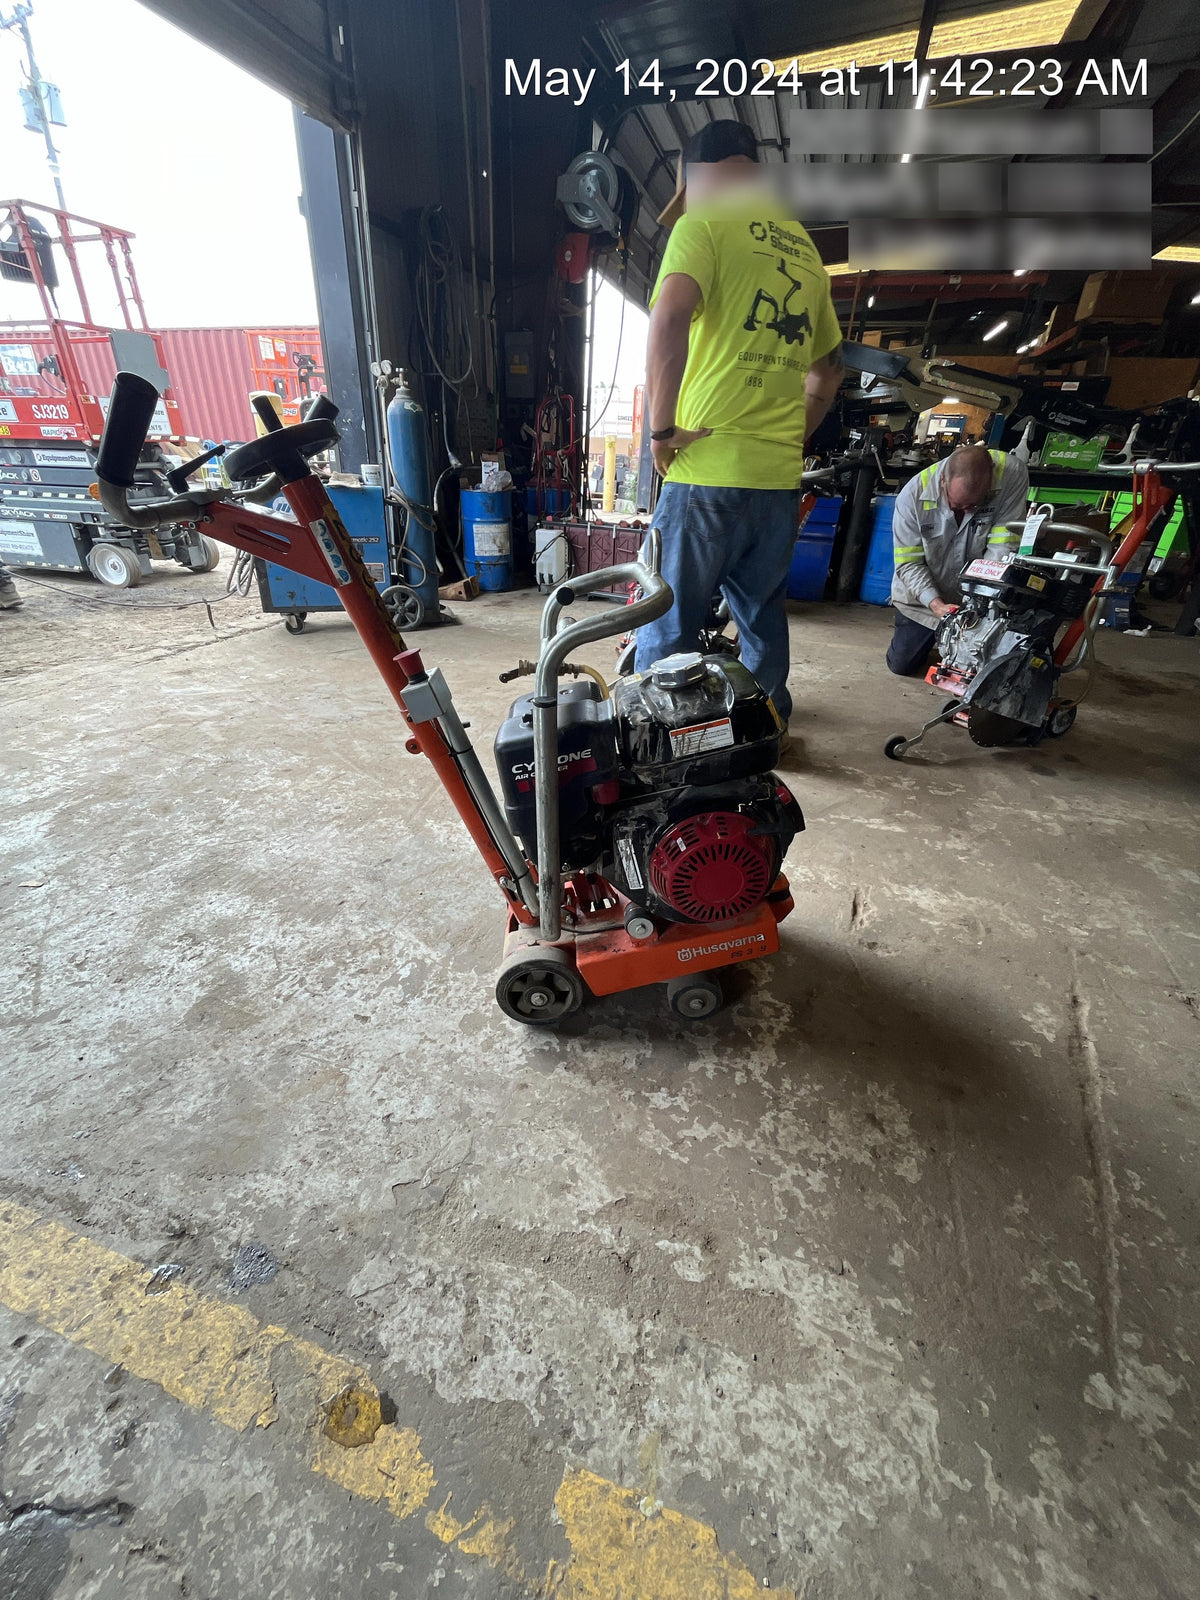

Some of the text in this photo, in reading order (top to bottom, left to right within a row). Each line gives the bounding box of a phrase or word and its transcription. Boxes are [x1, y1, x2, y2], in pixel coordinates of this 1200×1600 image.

[770, 236, 801, 258] Share
[31, 404, 70, 419] SJ3219
[1049, 450, 1080, 459] CASE
[984, 568, 1002, 577] ONLY
[511, 748, 592, 774] CYONE
[515, 773, 529, 781] AIR
[692, 933, 765, 957] Husqvarna
